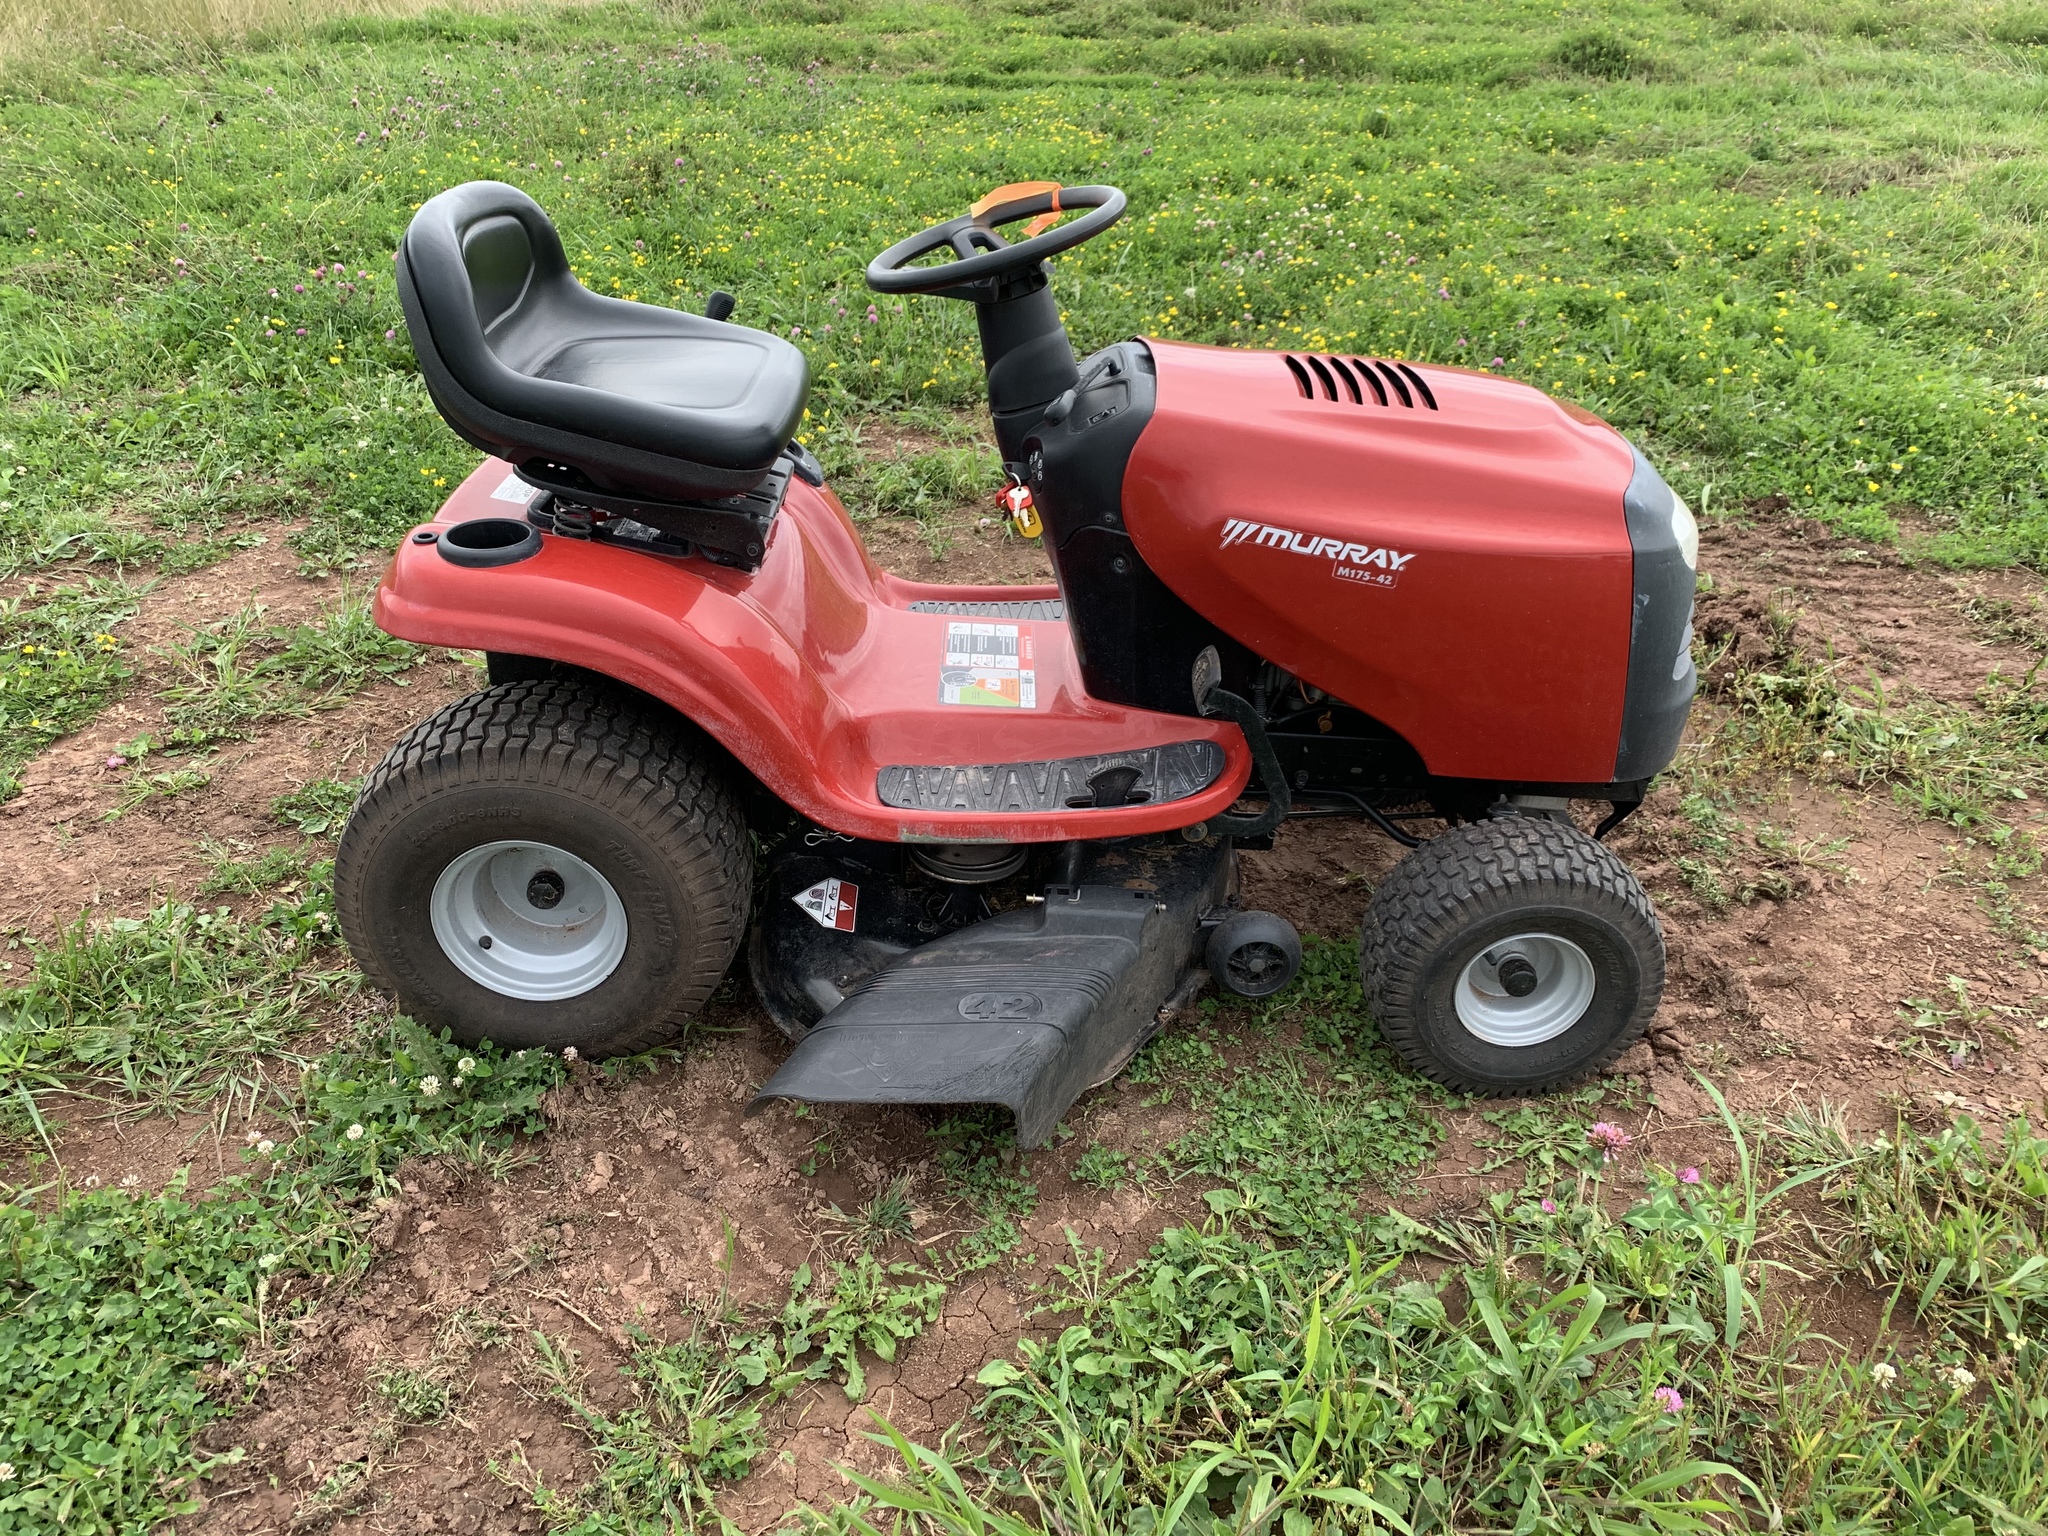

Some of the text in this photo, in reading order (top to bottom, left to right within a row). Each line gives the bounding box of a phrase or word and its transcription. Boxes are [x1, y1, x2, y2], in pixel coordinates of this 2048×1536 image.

[1255, 525, 1418, 571] MURRAY
[1337, 566, 1393, 585] M175-42
[965, 994, 1034, 1020] 42
